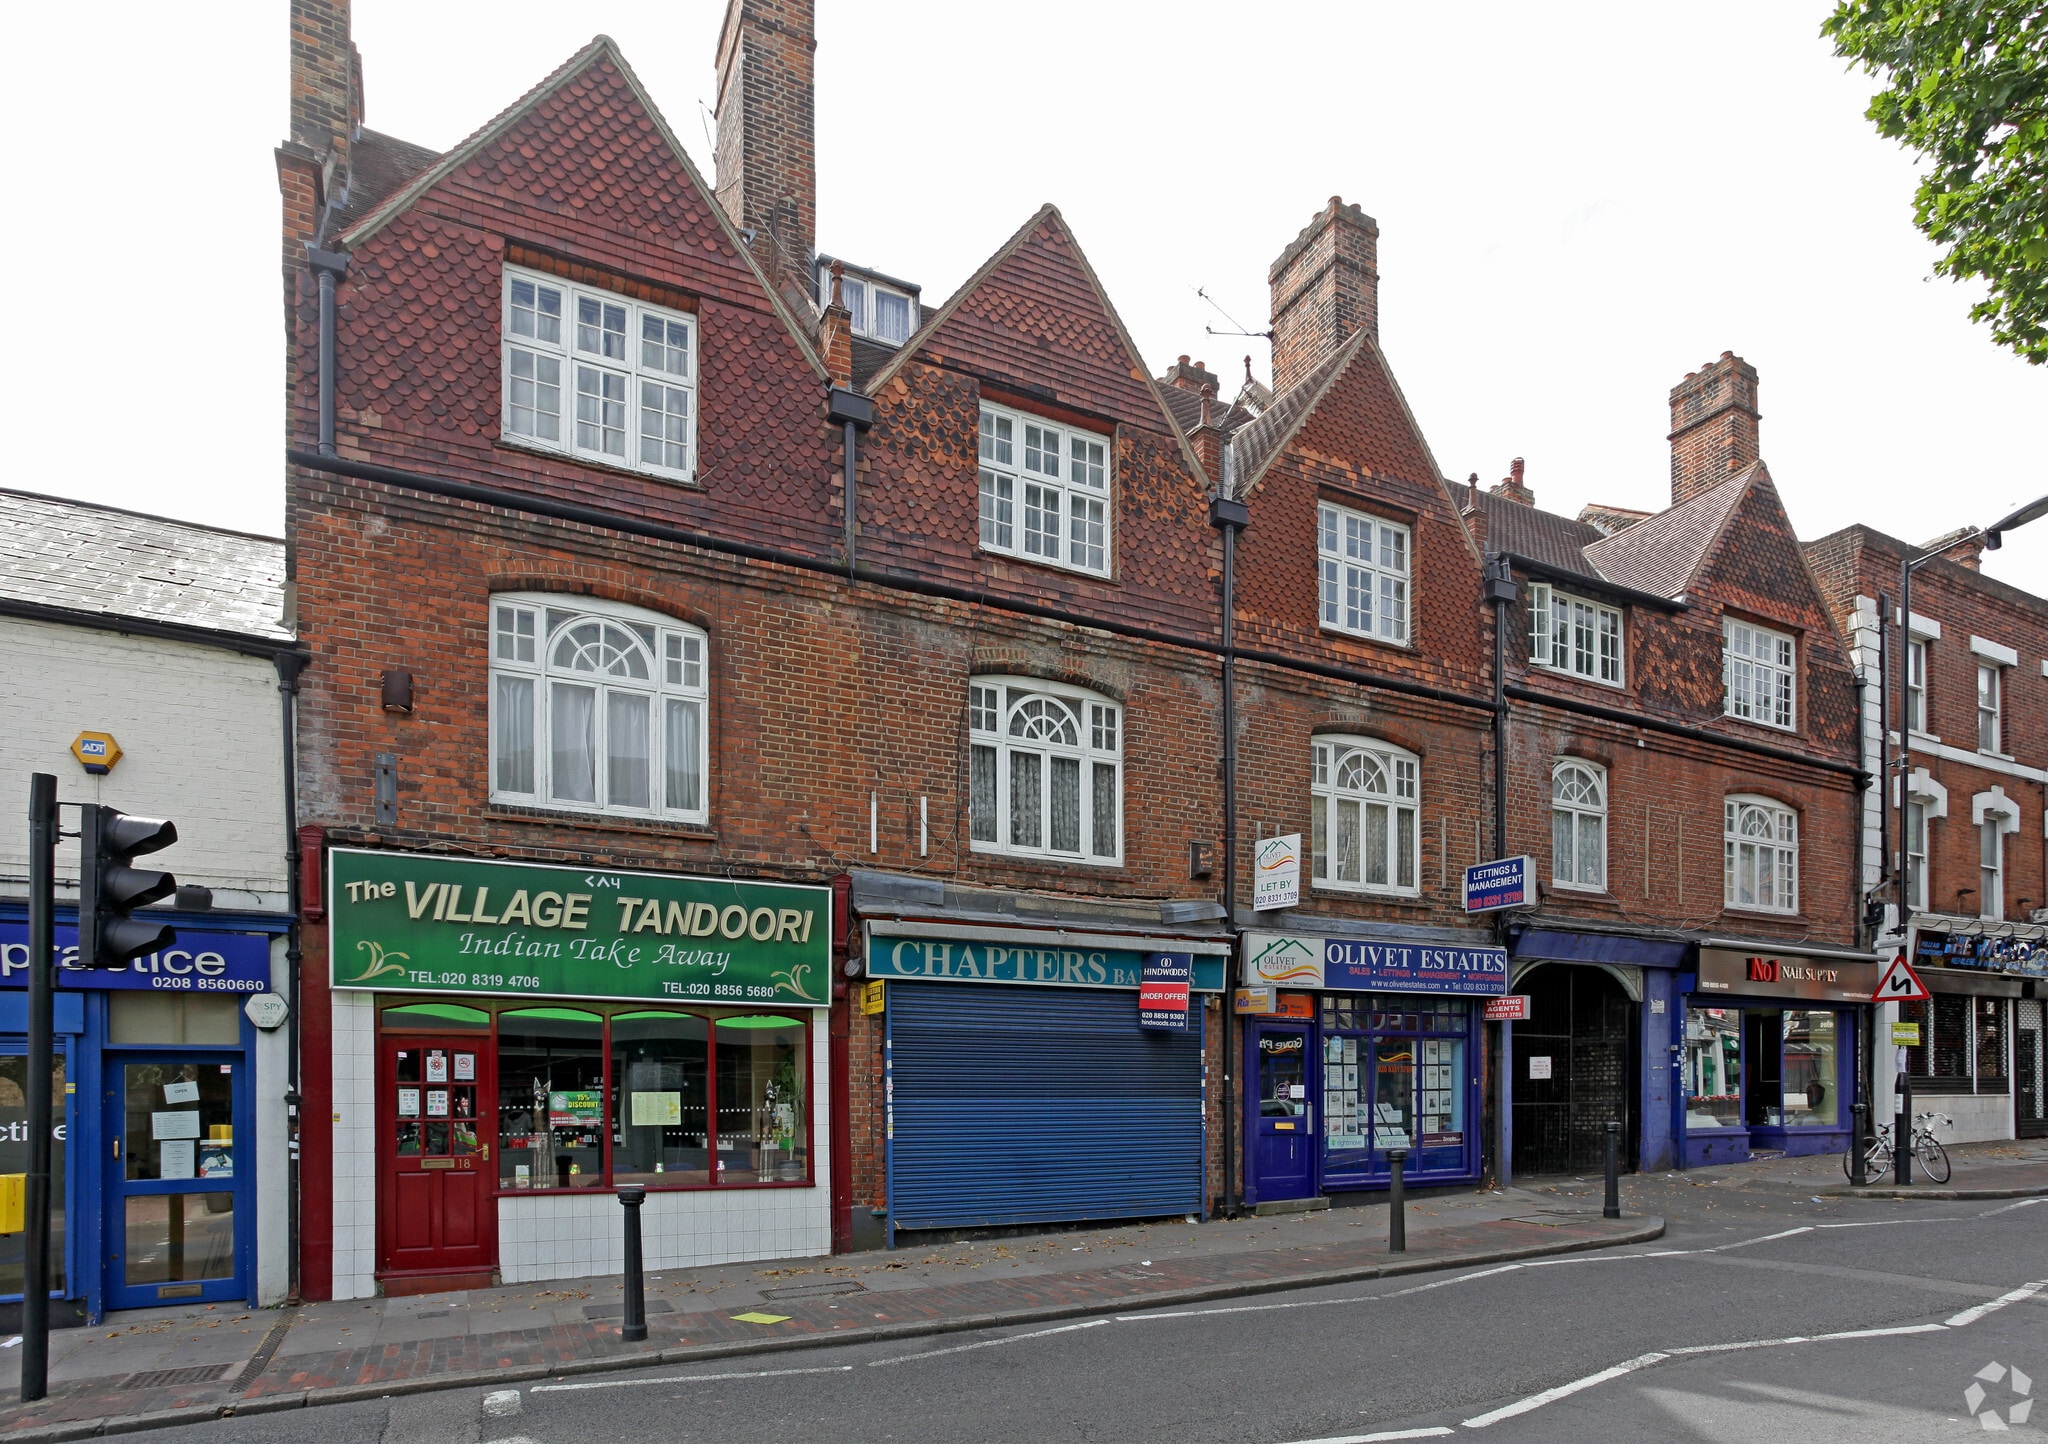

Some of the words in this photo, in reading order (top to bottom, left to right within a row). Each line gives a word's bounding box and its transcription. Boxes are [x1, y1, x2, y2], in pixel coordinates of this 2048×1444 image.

[82, 743, 105, 753] ADT
[1473, 865, 1510, 880] LETTINGS
[1511, 863, 1517, 873] &
[1261, 882, 1277, 892] LET
[1280, 880, 1292, 889] BY
[1468, 874, 1523, 892] MANAGEMENT
[1255, 896, 1266, 904] 020
[1268, 894, 1282, 903] 8331
[1284, 891, 1297, 900] 3709
[345, 880, 396, 903] The
[405, 881, 592, 930] VILLAGE
[616, 896, 814, 944] TANDOORI
[459, 931, 561, 958] Indian
[570, 938, 641, 969] Take
[652, 944, 731, 976] Away
[1326, 943, 1412, 968] OLIVET
[1420, 949, 1505, 972] ESTATES
[892, 941, 1107, 984] CHAPTERS
[1264, 956, 1296, 966] OLIVET
[408, 970, 466, 985] TEL:020
[472, 974, 503, 986] 8319
[508, 975, 540, 988] 4706
[1143, 968, 1188, 977] HINDWOODS
[1349, 967, 1371, 976] SALES
[1378, 968, 1411, 978] LETTINGS
[1417, 971, 1461, 980] MANAGEMENT
[1468, 973, 1505, 982] MORTGAGES
[1782, 966, 1804, 979] NAIL
[1805, 968, 1838, 983] SUPPLY
[152, 977, 191, 989] 0208
[198, 979, 265, 991] 8560660
[662, 982, 710, 995] TEL:020
[714, 983, 743, 996] 8856
[746, 985, 774, 998] 5680
[1371, 979, 1441, 990] www.olivetestates.com
[1452, 982, 1462, 990] Tel:
[1463, 983, 1474, 991] 020
[1475, 983, 1489, 991] 8331
[1490, 984, 1505, 992] 3709
[1140, 992, 1163, 1000] UNDER
[1237, 996, 1250, 1007] Ria
[1141, 1019, 1184, 1027] hindwoods.co.uk
[1337, 1138, 1361, 1146] rightmove
[459, 1158, 470, 1168] 18
